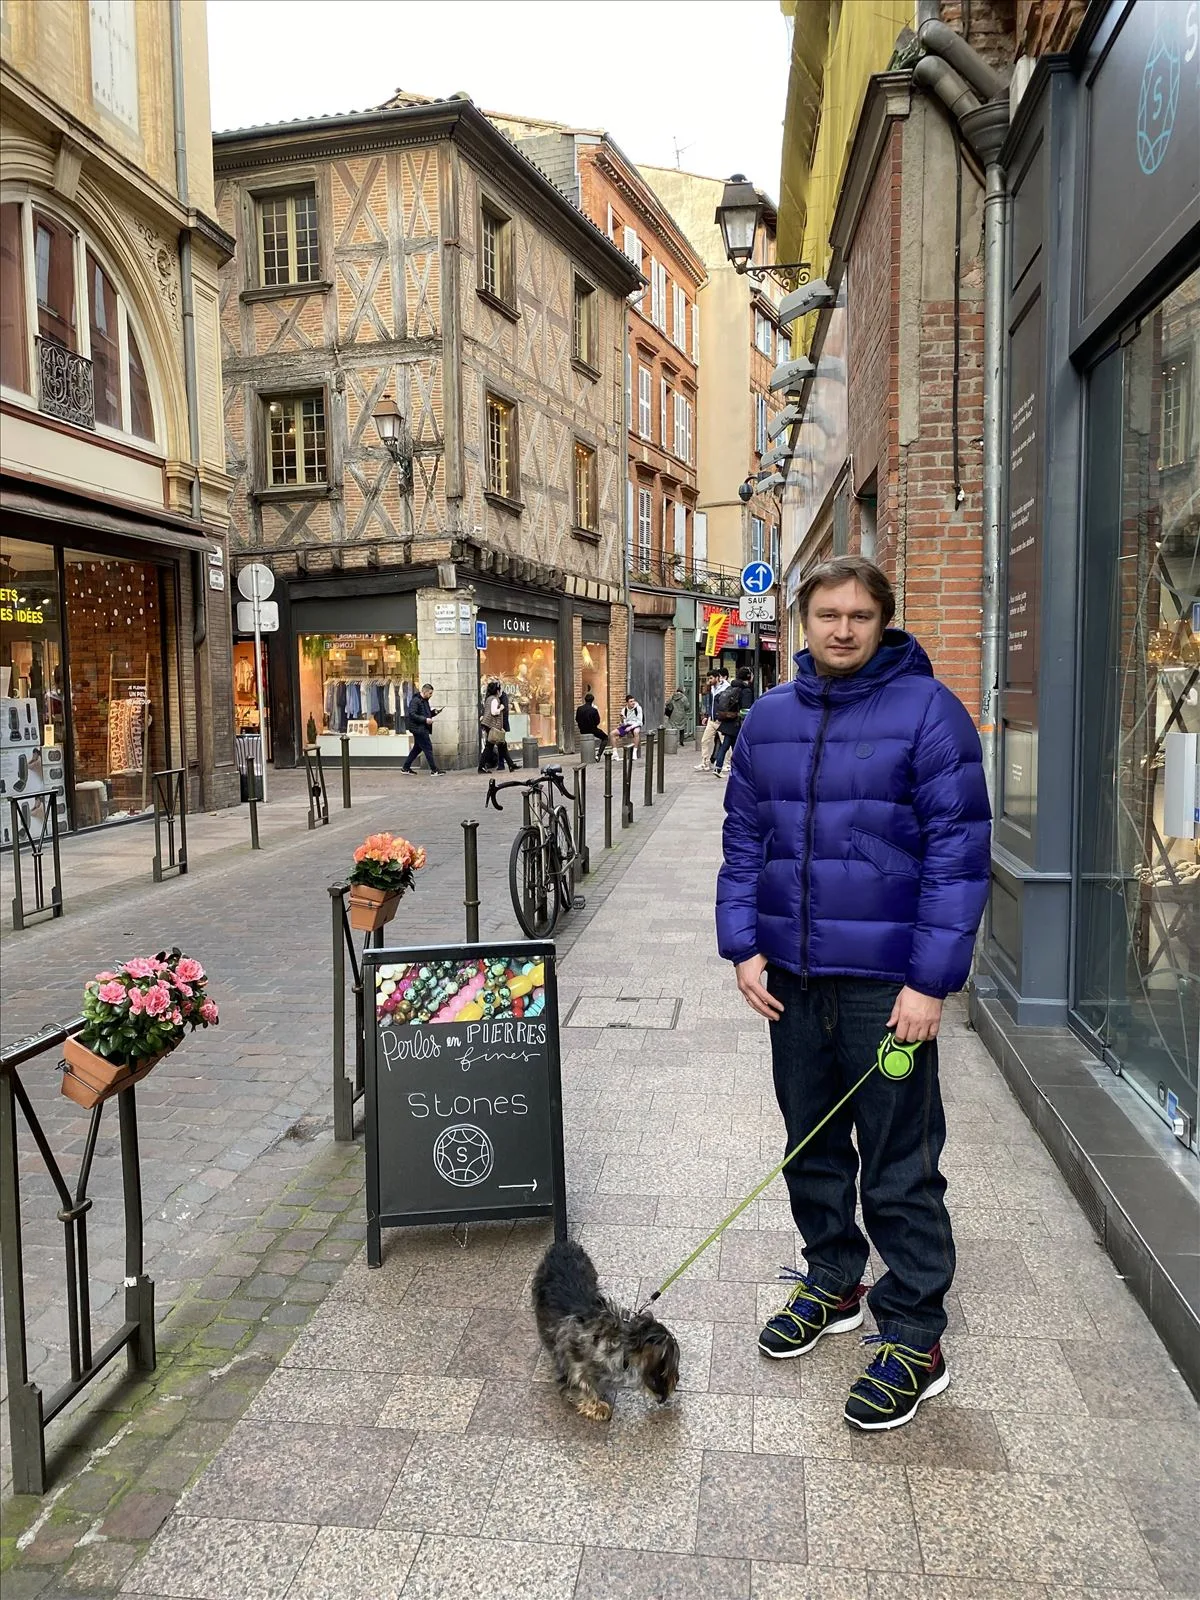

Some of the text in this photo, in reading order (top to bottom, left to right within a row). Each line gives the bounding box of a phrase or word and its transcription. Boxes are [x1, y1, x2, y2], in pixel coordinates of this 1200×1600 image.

[1153, 75, 1163, 120] S
[0, 608, 13, 621] ES
[503, 617, 530, 632] ICÔNE
[380, 1021, 547, 1071] Perles en PIERRES
[454, 1047, 541, 1071] fines
[408, 1092, 528, 1118] Stones
[456, 1147, 468, 1163] S
